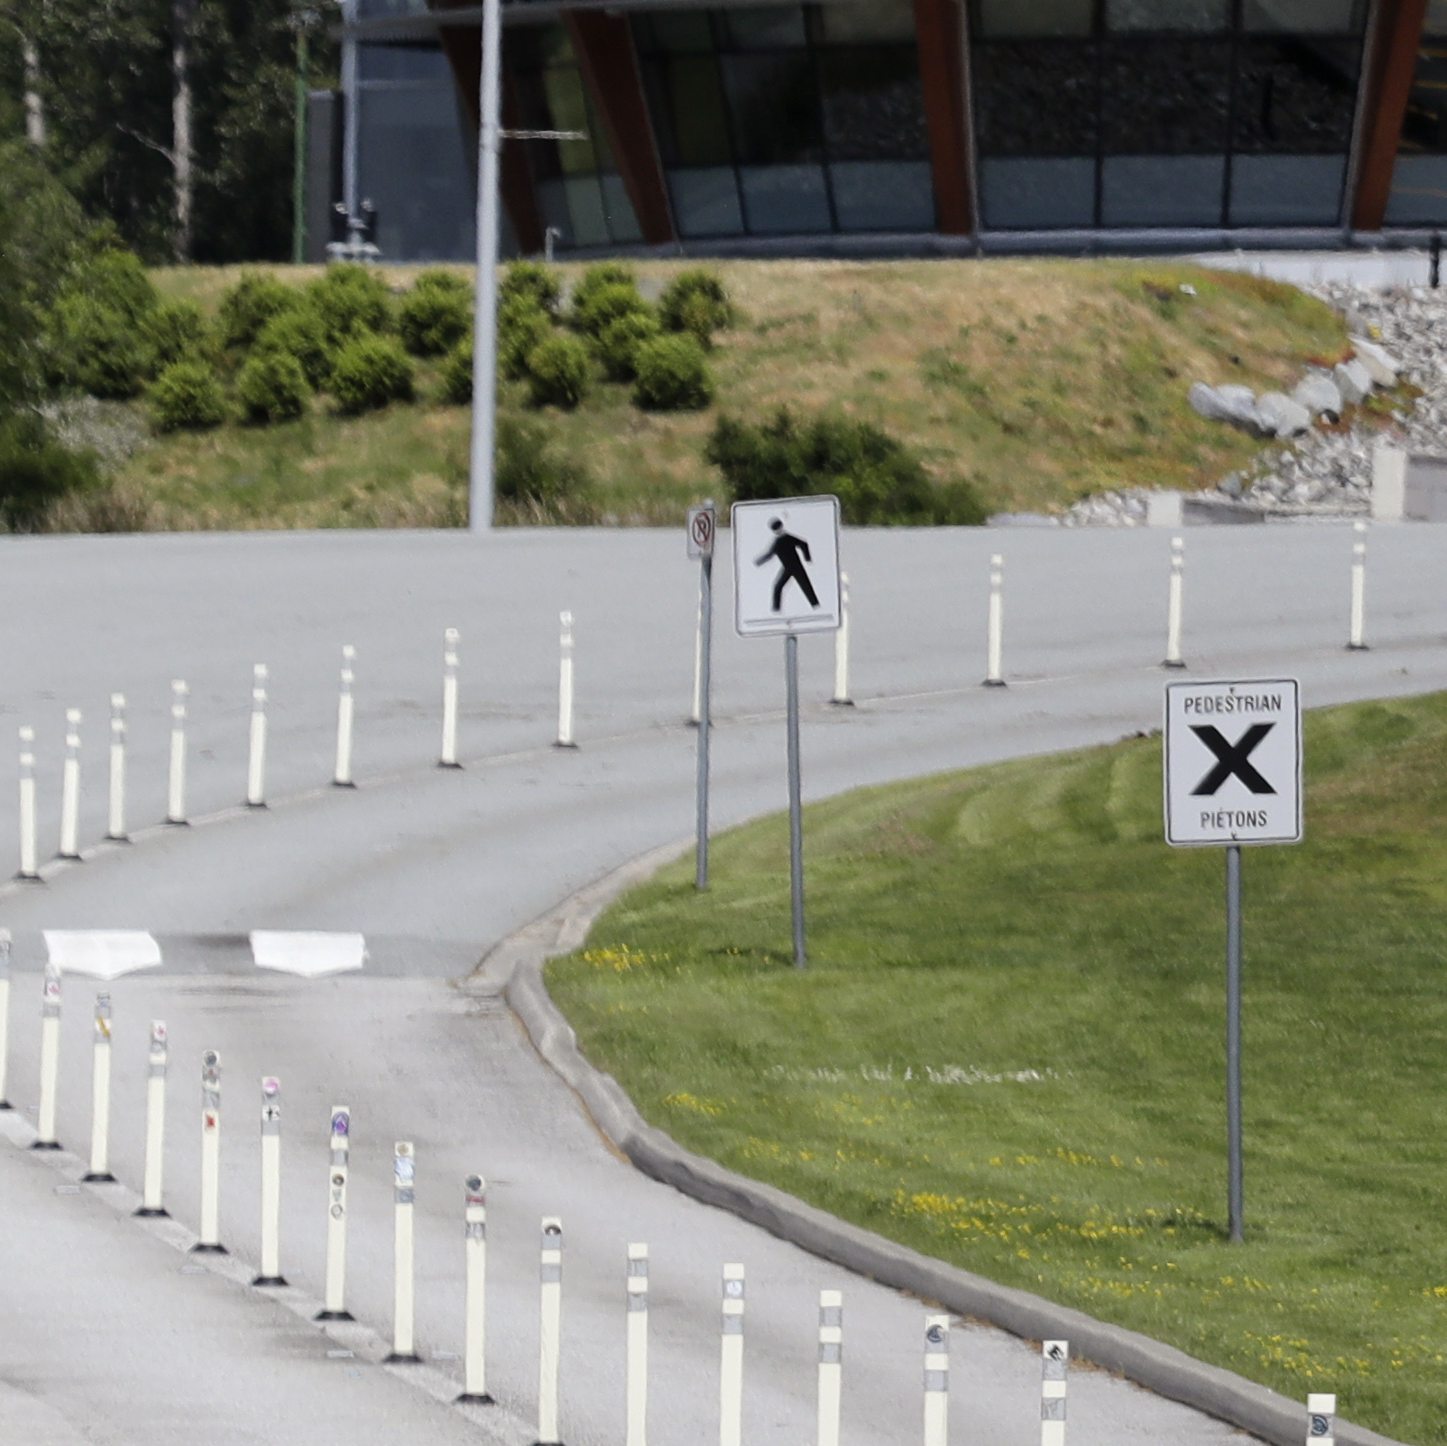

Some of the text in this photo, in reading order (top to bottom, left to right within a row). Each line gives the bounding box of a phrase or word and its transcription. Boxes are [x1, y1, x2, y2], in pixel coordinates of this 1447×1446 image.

[1184, 694, 1282, 714] PEDESTRIAN
[1187, 721, 1279, 796] X
[1200, 808, 1268, 829] PIÉTONS
